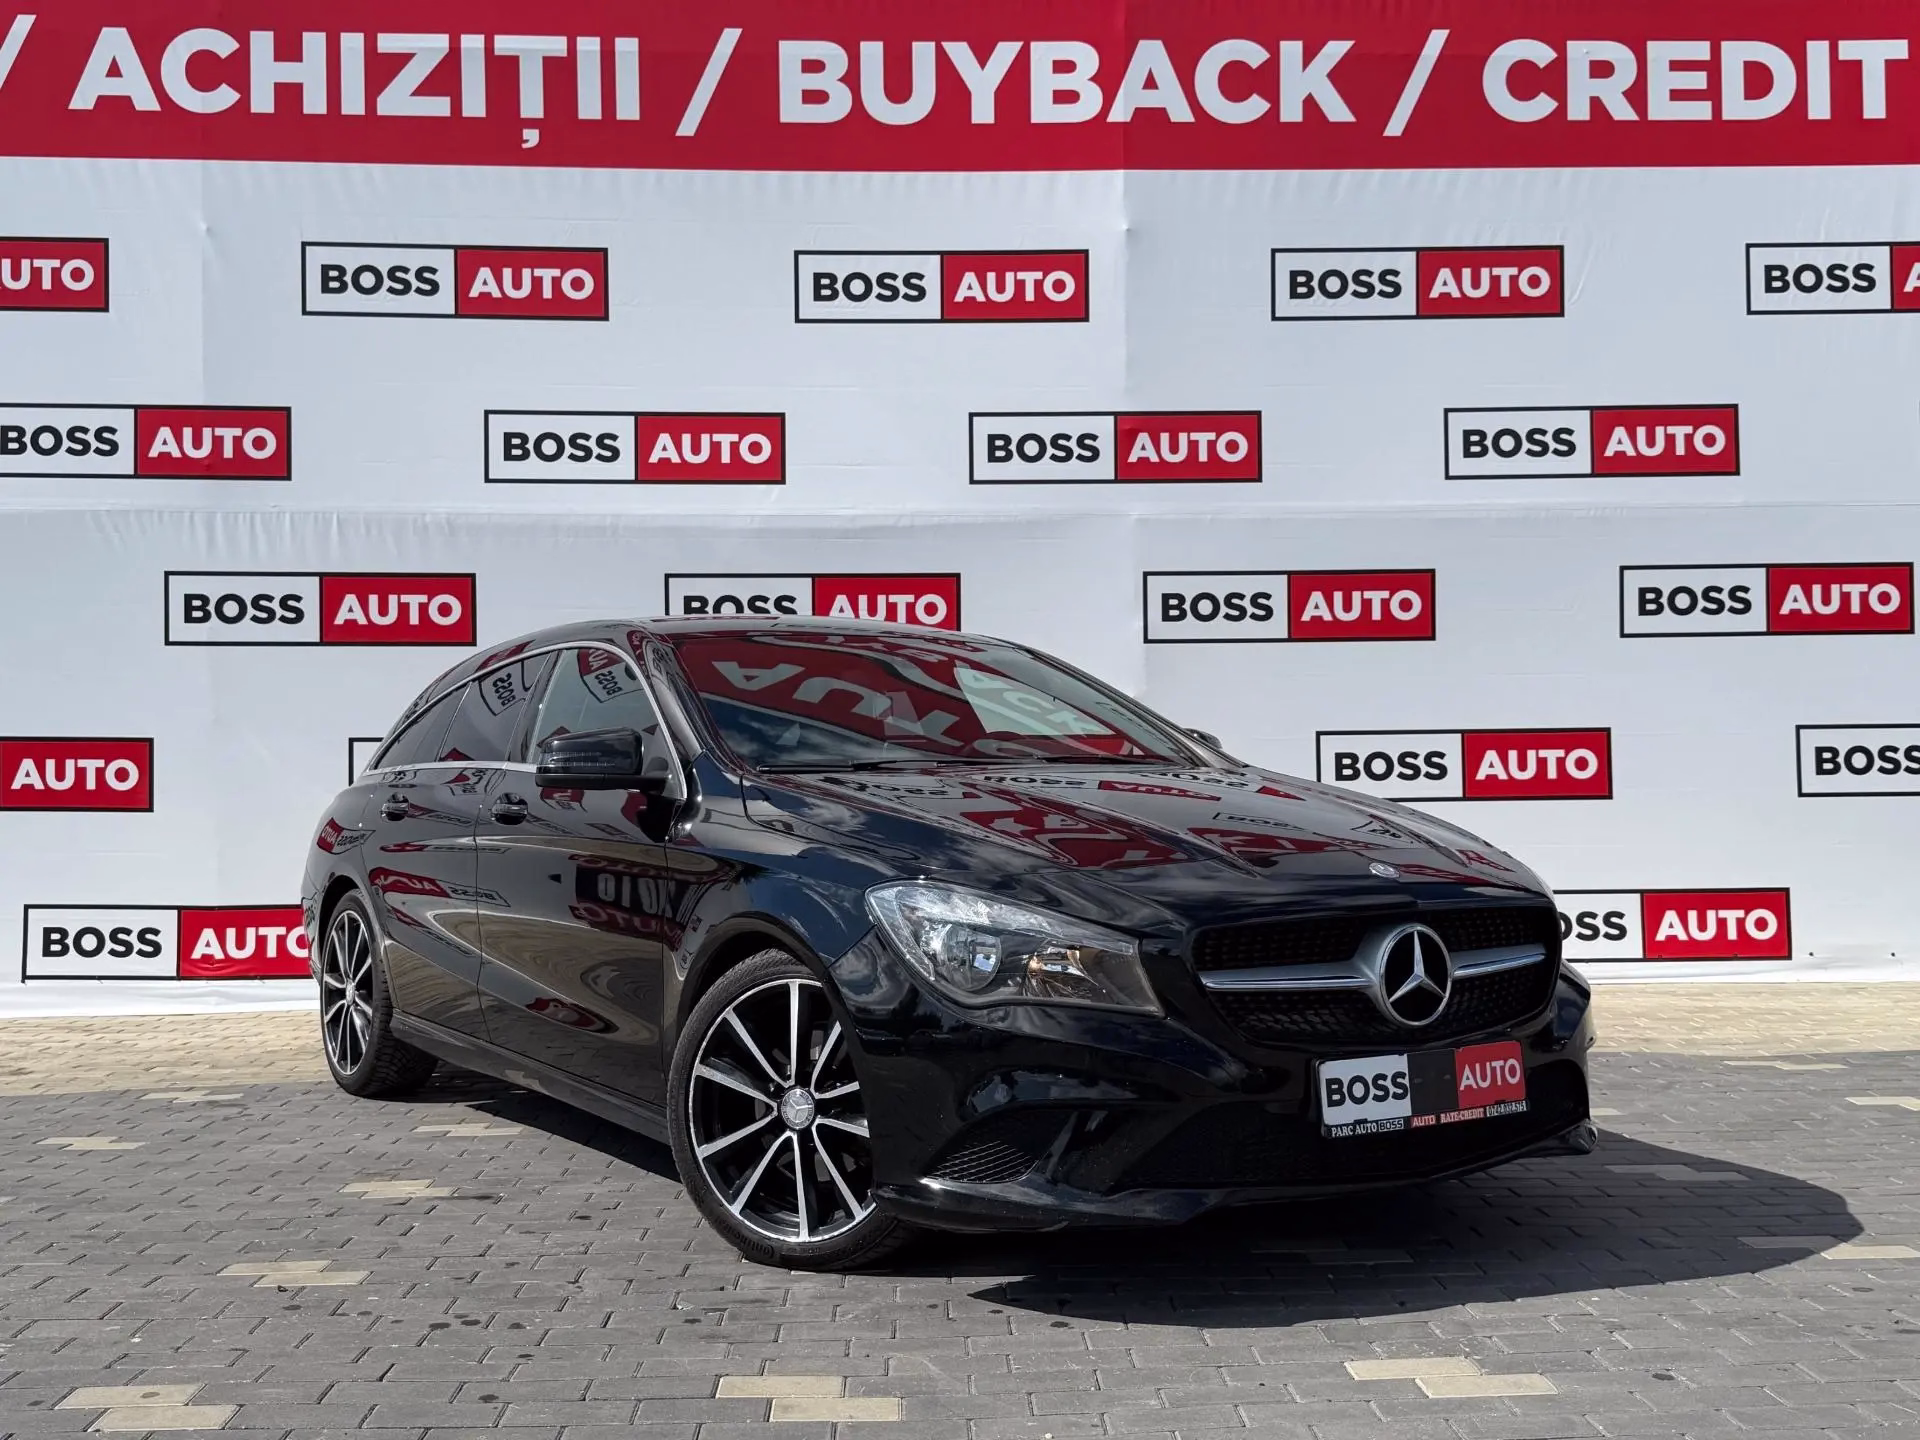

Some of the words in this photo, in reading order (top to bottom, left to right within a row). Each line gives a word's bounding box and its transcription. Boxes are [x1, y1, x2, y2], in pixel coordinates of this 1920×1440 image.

[68, 27, 640, 148] ACHIZIȚII
[778, 40, 1355, 126] BUYBACK
[1483, 39, 1908, 123] CREDIT
[0, 259, 95, 291] UTO
[320, 264, 440, 297] BOSS
[468, 267, 595, 300] AUTO
[812, 271, 927, 303] BOSS
[954, 270, 1076, 303] AUTO
[1289, 268, 1402, 300] BOSS
[1429, 266, 1551, 299] AUTO
[1764, 263, 1877, 294] BOSS
[0, 425, 120, 457] BOSS
[148, 426, 277, 460] AUTO
[503, 431, 621, 463] BOSS
[648, 432, 772, 465] AUTO
[987, 432, 1100, 464] BOSS
[1127, 431, 1249, 463] AUTO
[1462, 427, 1577, 459] BOSS
[1604, 424, 1726, 457] AUTO
[183, 593, 305, 625] BOSS
[334, 593, 462, 626] AUTO
[828, 593, 948, 625] AUTO
[1161, 591, 1274, 623] BOSS
[1301, 589, 1422, 622] AUTO
[1638, 584, 1752, 617] BOSS
[1779, 583, 1901, 615] AUTO
[11, 758, 139, 791] AUTO
[1334, 750, 1448, 782] BOSS
[1475, 748, 1598, 780] AUTO
[1814, 744, 1920, 776] BOSS
[42, 926, 162, 959] BOSS
[191, 924, 309, 959] AUTO
[1655, 908, 1778, 941] AUTO
[1325, 1071, 1409, 1108] BOSS
[1459, 1058, 1521, 1091] AUTO
[1331, 1125, 1354, 1138] PARC
[1355, 1122, 1378, 1135] AUTO
[1379, 1119, 1404, 1131] BOSS
[1412, 1115, 1436, 1127] AUTO
